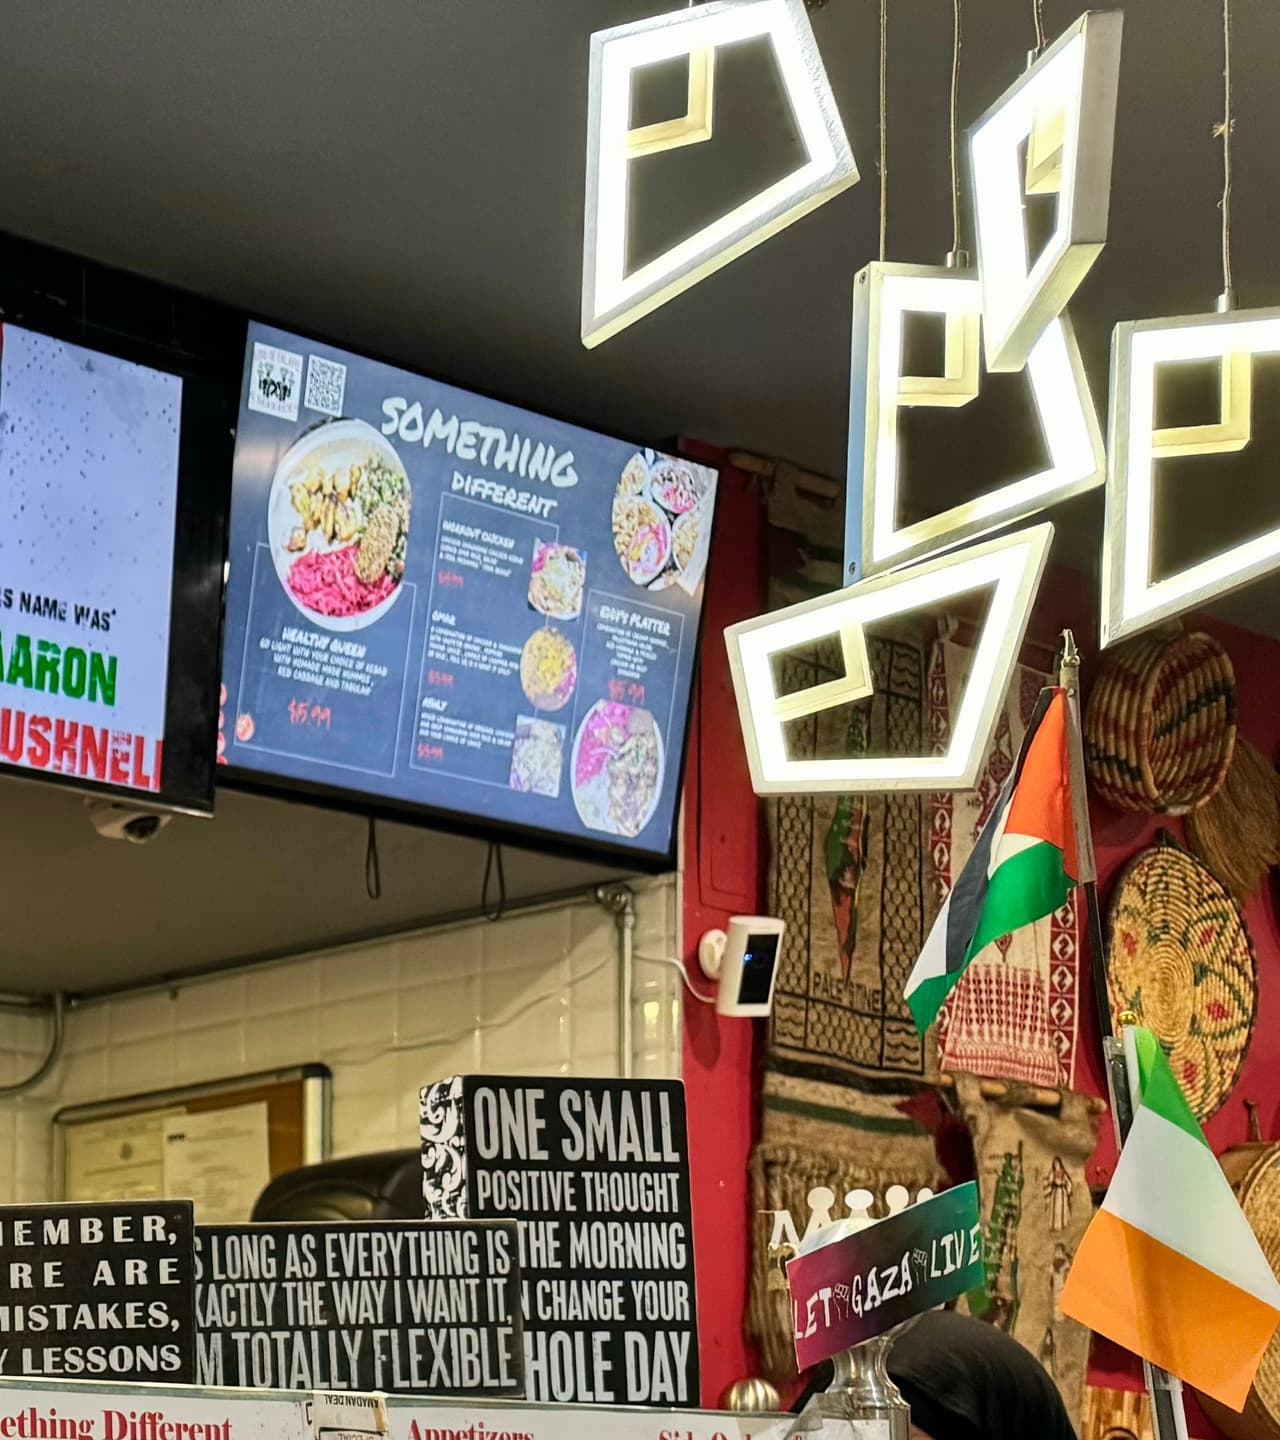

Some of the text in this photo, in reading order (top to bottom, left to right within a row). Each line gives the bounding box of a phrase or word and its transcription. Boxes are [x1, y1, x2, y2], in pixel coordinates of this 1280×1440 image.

[380, 397, 579, 488] SOMETHING
[451, 471, 557, 518] DIFFERENT
[20, 592, 68, 622] NAME
[474, 1087, 680, 1163] ONE SMALL
[476, 1170, 680, 1213] POSITIVE THOUGHT
[211, 1230, 512, 1281] LONG AS EVERYTHING IS
[518, 1221, 687, 1270] THE MORNING
[92, 1257, 182, 1288] ARE
[794, 1223, 981, 1340] LET GAZA LIVE
[194, 1277, 513, 1329] XACTLY THE WAY I WANT IT,
[536, 1280, 690, 1321] CHANGE YOUR
[22, 1343, 182, 1375] LESSONS
[231, 1326, 517, 1390] TOTALLY FLEXIBLE
[525, 1331, 690, 1402] HOLE DAY
